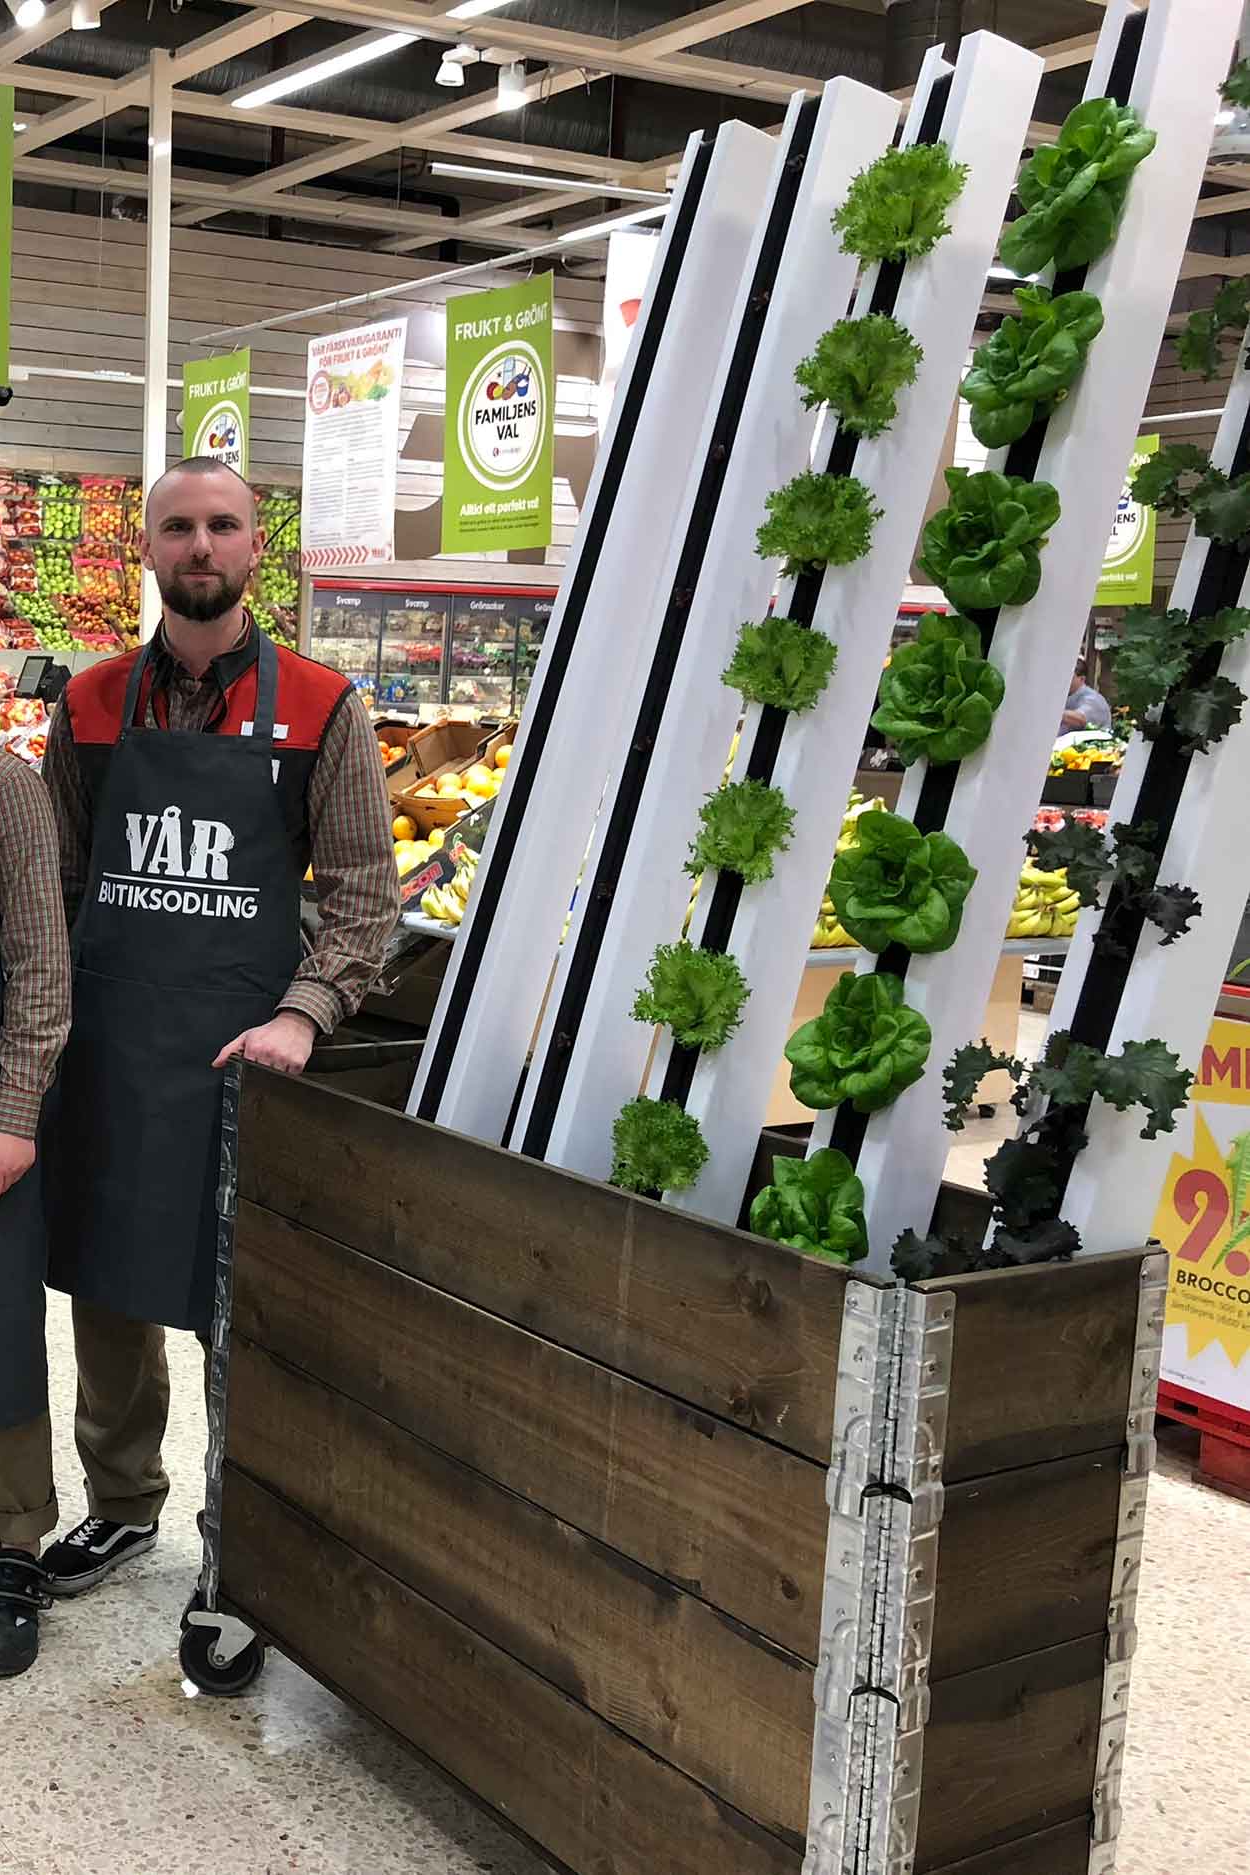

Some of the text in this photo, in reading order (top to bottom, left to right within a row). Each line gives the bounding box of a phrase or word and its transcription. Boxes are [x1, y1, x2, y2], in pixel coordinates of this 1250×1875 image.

[454, 301, 549, 342] FRUKT & GRÖNT
[188, 379, 219, 401] FRUKT
[219, 378, 226, 394] &
[474, 399, 537, 426] FAMILJENS
[496, 423, 520, 441] VAL
[124, 804, 235, 882] VÅR
[97, 880, 260, 920] BUTIKSODLING
[1175, 1268, 1250, 1305] BROCCO
